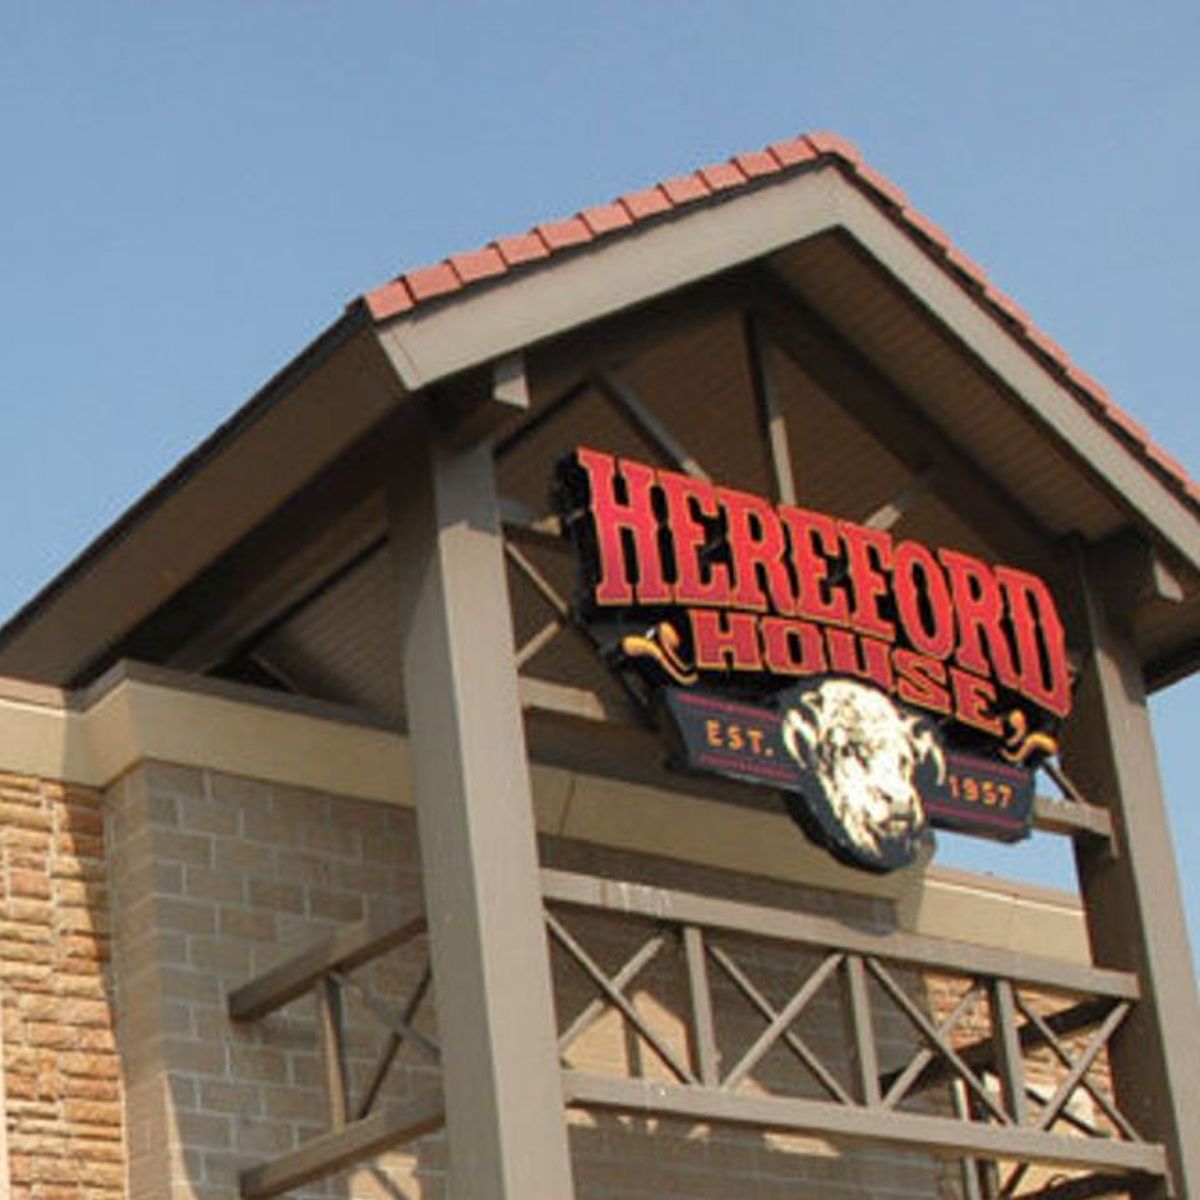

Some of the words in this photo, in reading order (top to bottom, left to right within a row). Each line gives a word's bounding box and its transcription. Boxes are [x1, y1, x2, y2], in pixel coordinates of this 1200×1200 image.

[577, 446, 1072, 718] HEREFORD
[688, 608, 1004, 736] HOUSE
[706, 719, 775, 757] EST.
[949, 776, 1013, 808] 1957
